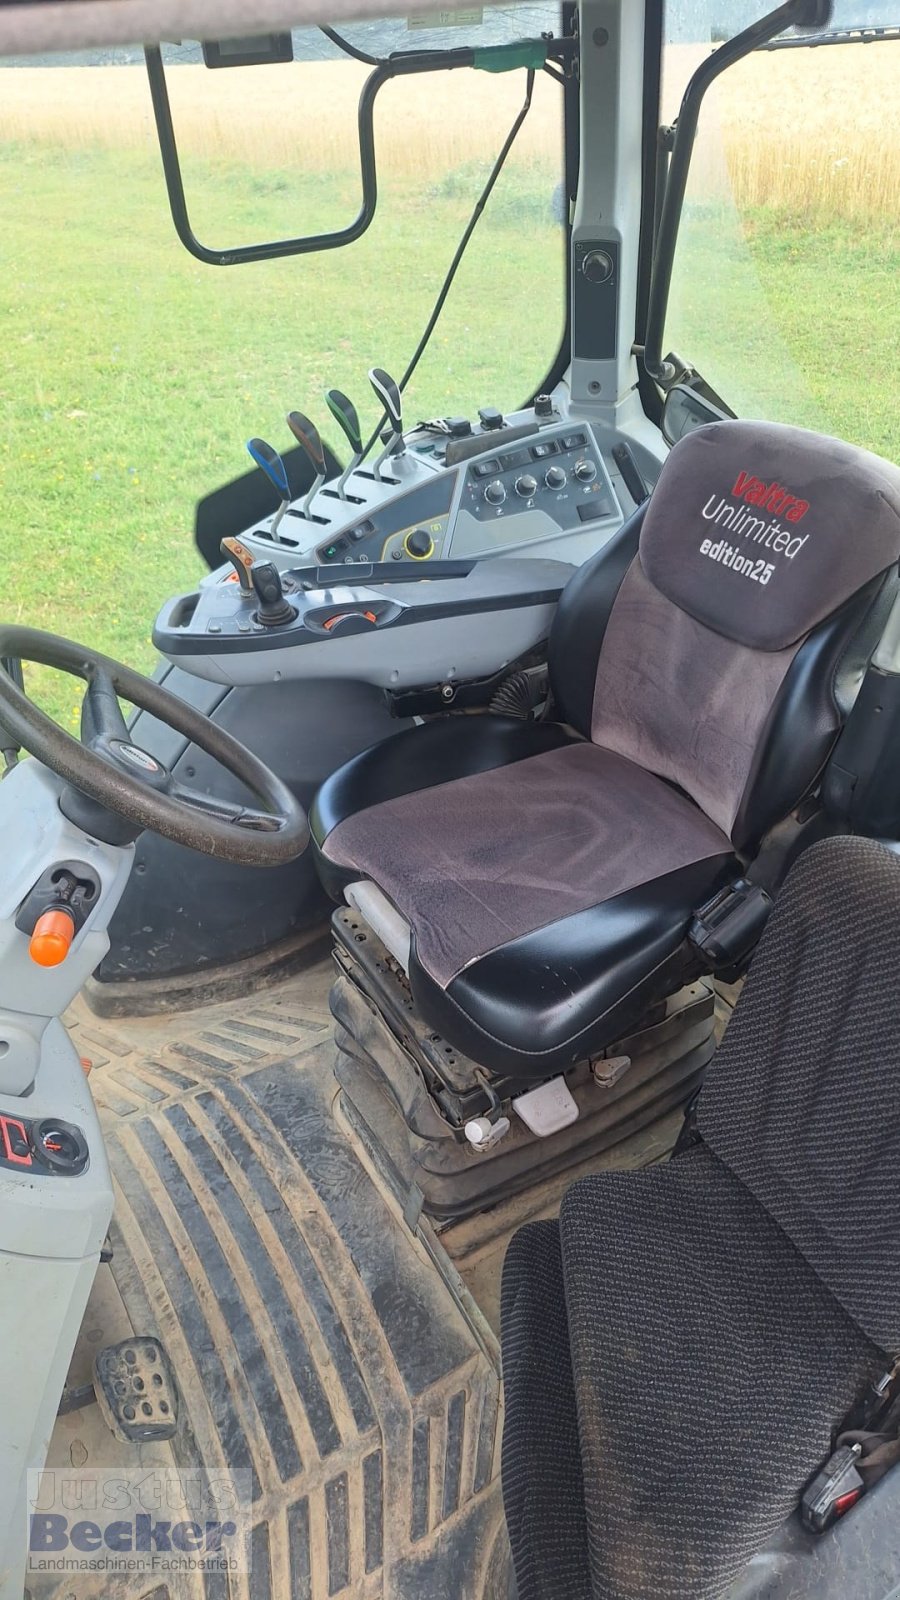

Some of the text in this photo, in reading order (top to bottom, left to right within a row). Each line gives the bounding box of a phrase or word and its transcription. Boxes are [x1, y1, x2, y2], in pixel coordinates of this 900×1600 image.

[732, 471, 810, 523] Valtra
[702, 494, 810, 559] Unlimited
[699, 538, 775, 585] edition25
